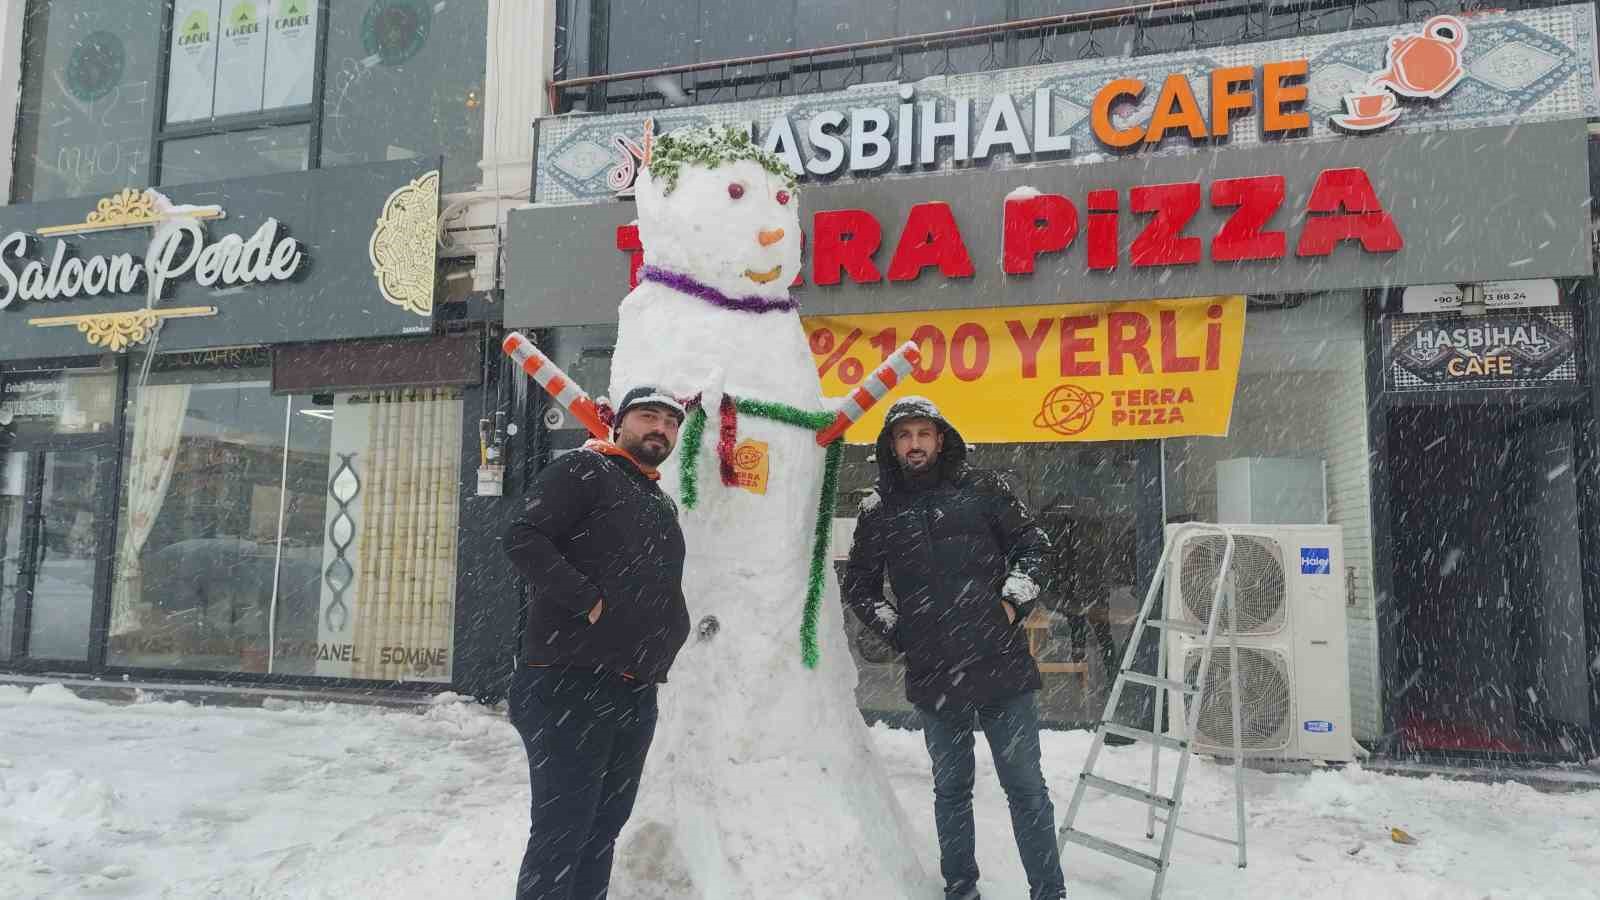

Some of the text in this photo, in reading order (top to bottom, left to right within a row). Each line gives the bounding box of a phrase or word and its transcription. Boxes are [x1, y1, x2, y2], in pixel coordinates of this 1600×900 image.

[747, 59, 1311, 176] ASBİHAL CAFE
[0, 217, 301, 310] Saloon Perde
[1448, 355, 1513, 377] CAFE
[1111, 387, 1194, 407] TERRA
